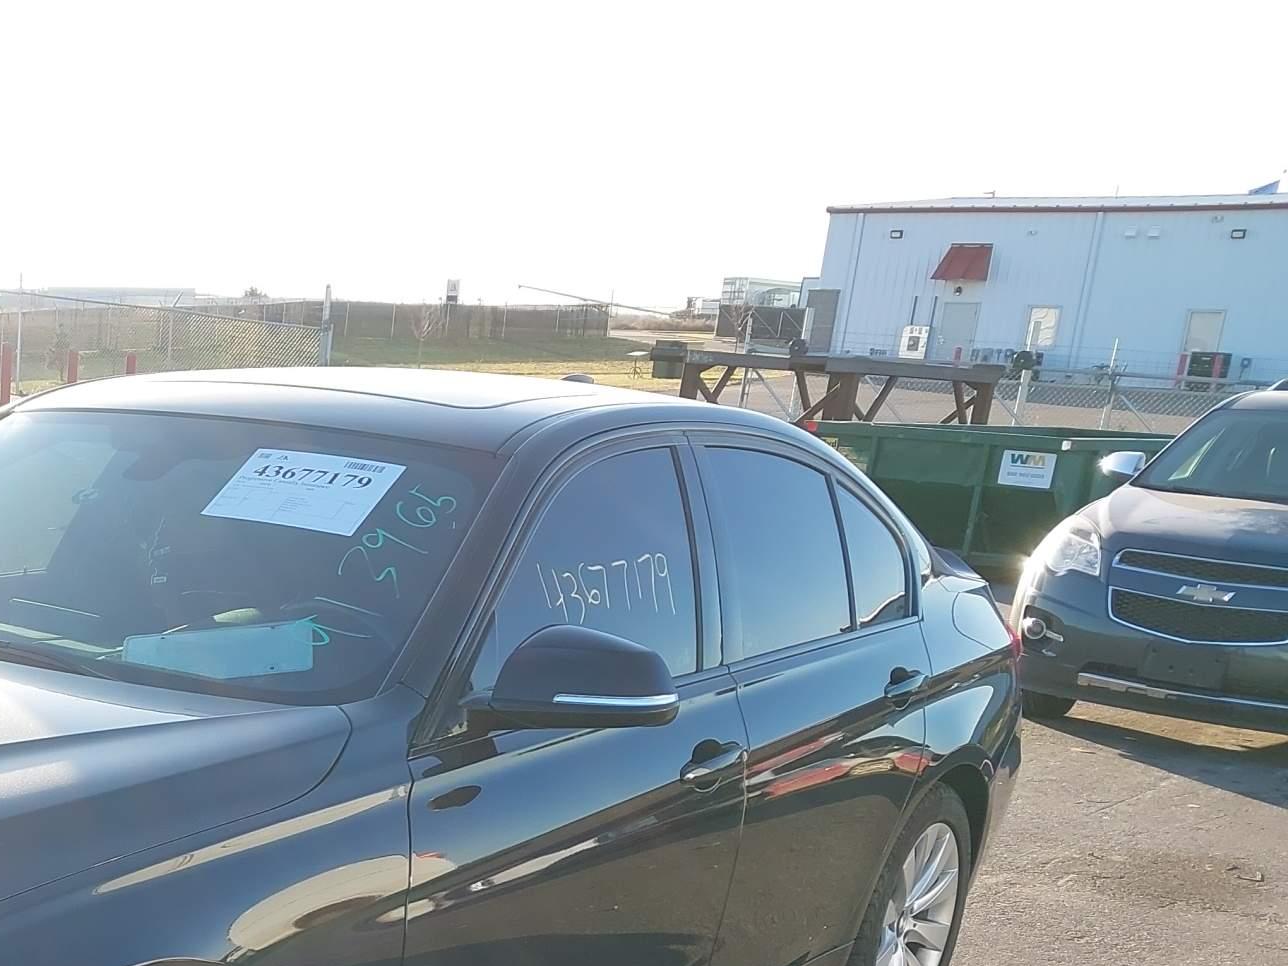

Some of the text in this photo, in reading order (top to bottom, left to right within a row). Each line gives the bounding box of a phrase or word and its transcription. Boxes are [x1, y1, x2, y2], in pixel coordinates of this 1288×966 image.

[1010, 453, 1047, 466] WM
[253, 464, 373, 489] 43677179
[536, 553, 676, 625] 43677179
